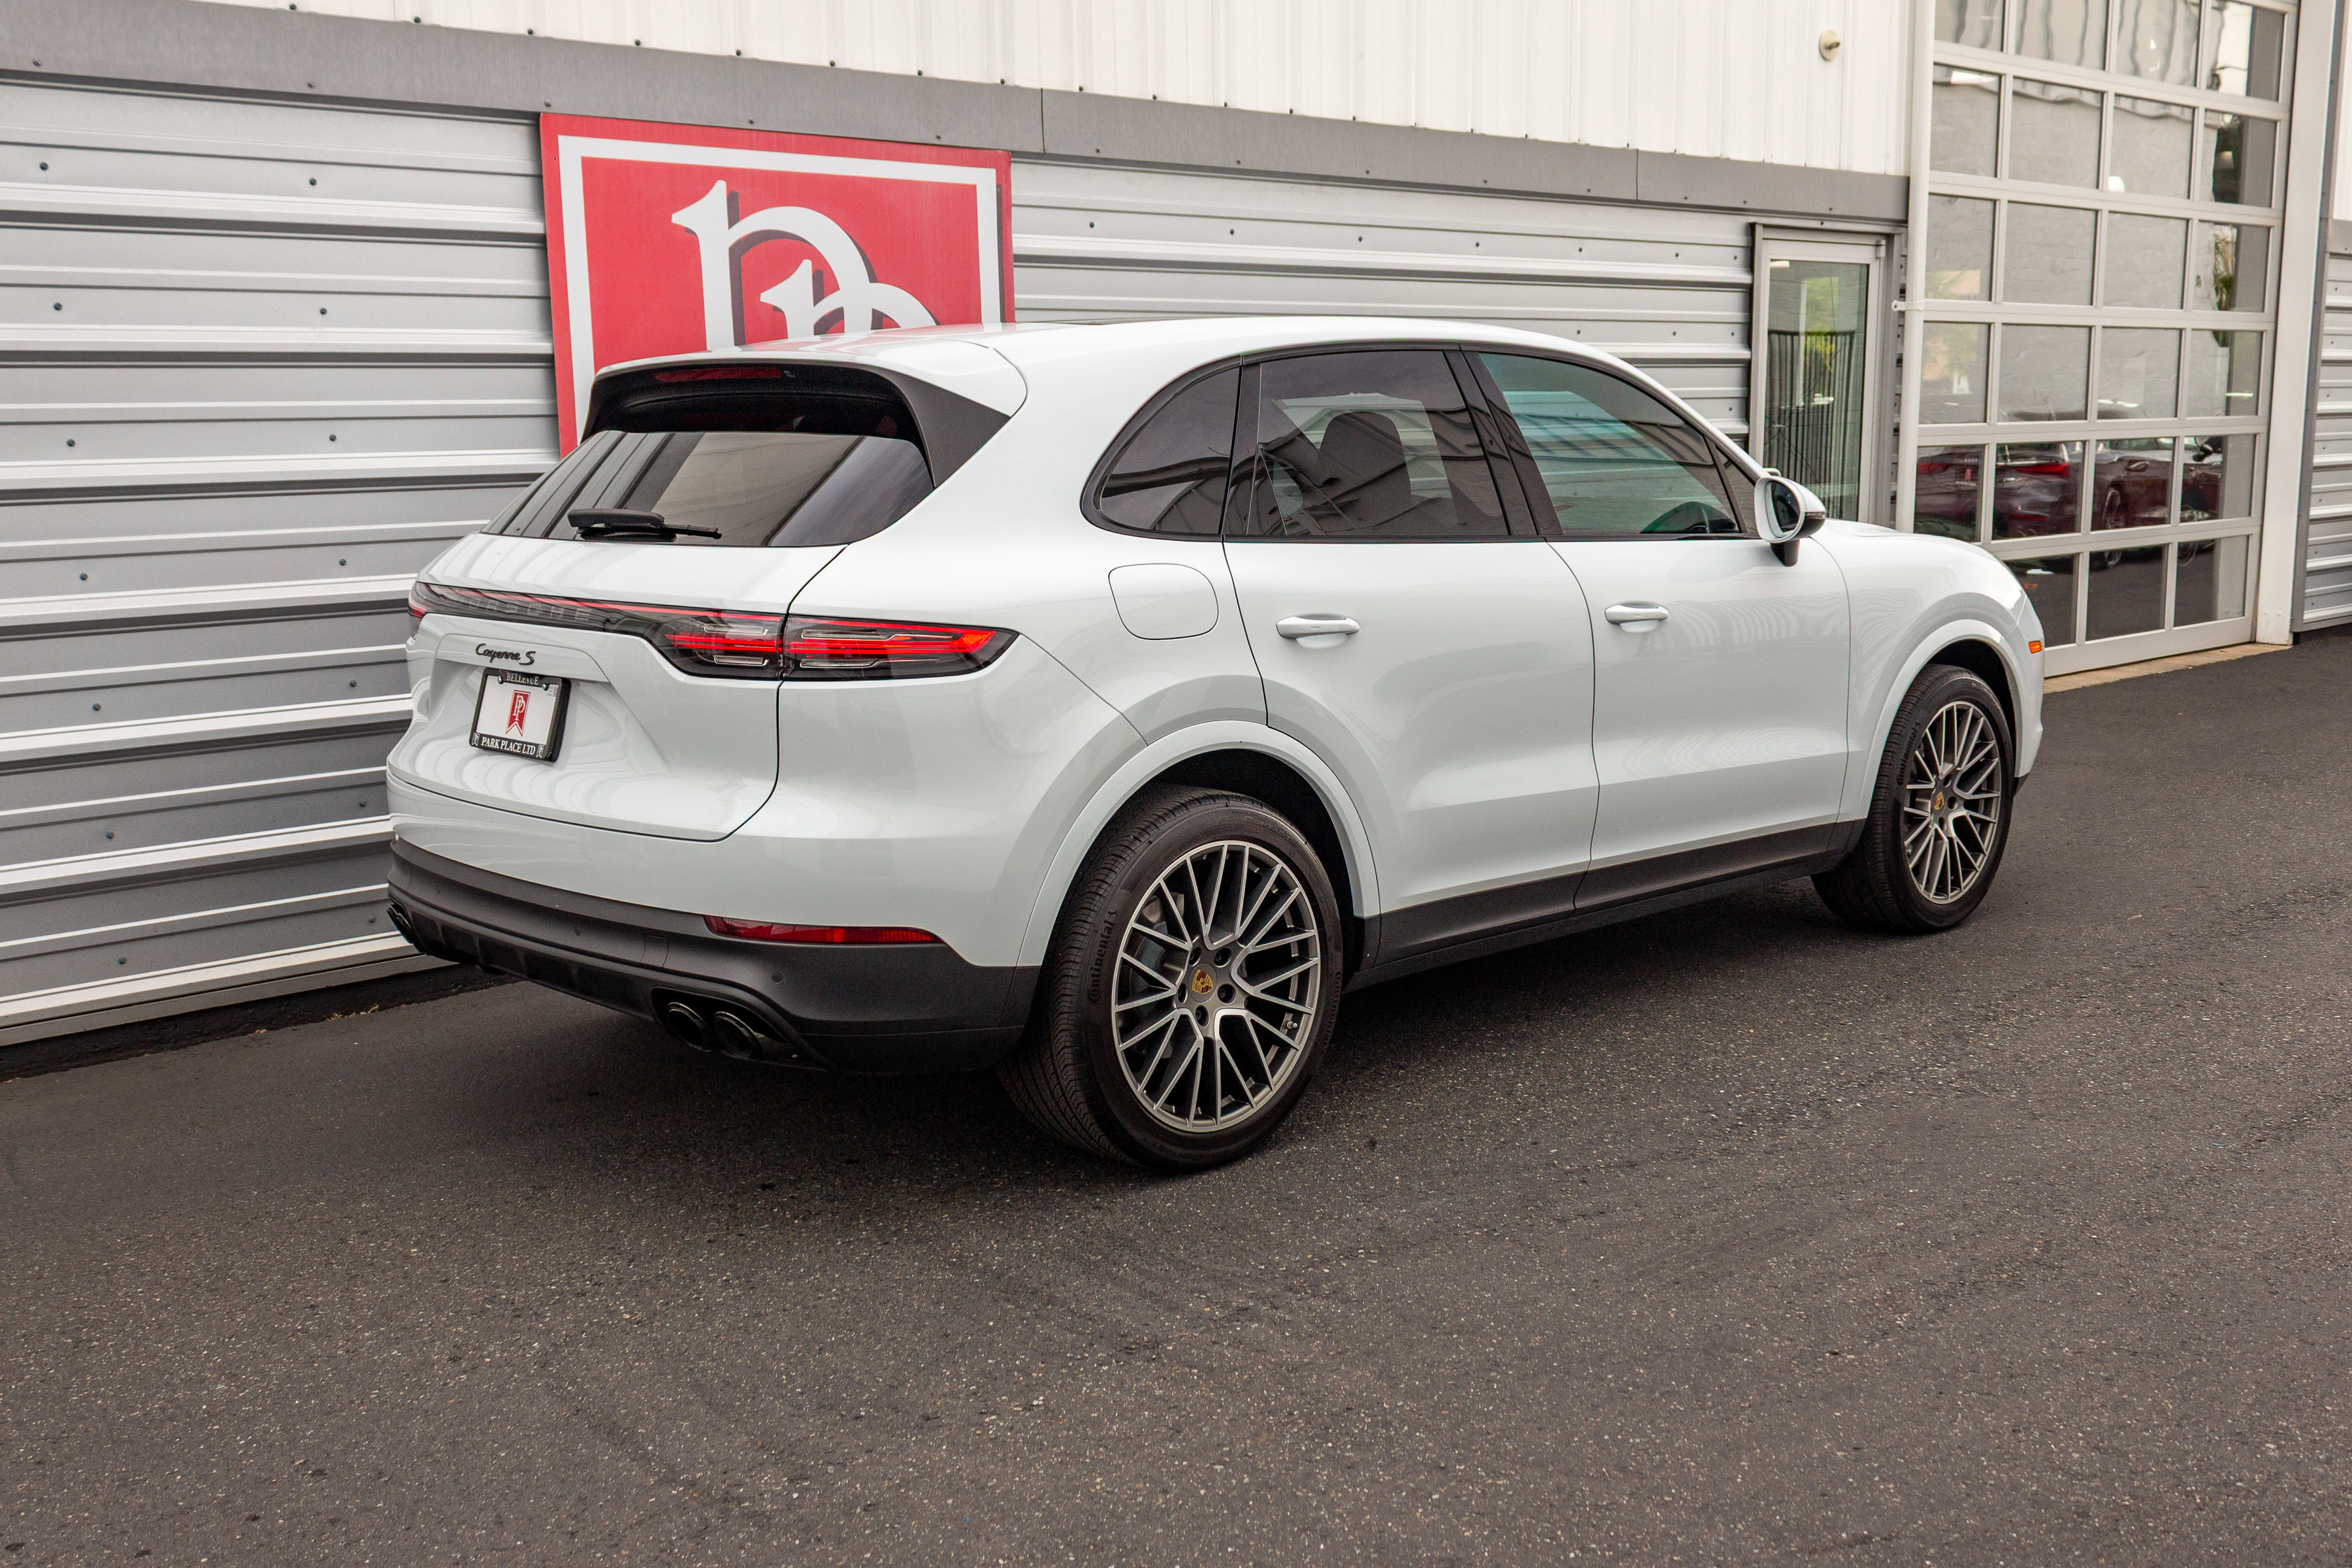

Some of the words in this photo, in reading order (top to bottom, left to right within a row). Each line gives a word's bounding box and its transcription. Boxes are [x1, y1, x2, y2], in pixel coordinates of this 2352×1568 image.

[476, 643, 521, 663] Cayenne
[519, 651, 536, 665] S
[481, 736, 500, 749] PARK
[500, 740, 522, 753] PLACE
[521, 743, 536, 755] LTD
[1087, 919, 1115, 1004] Continental
